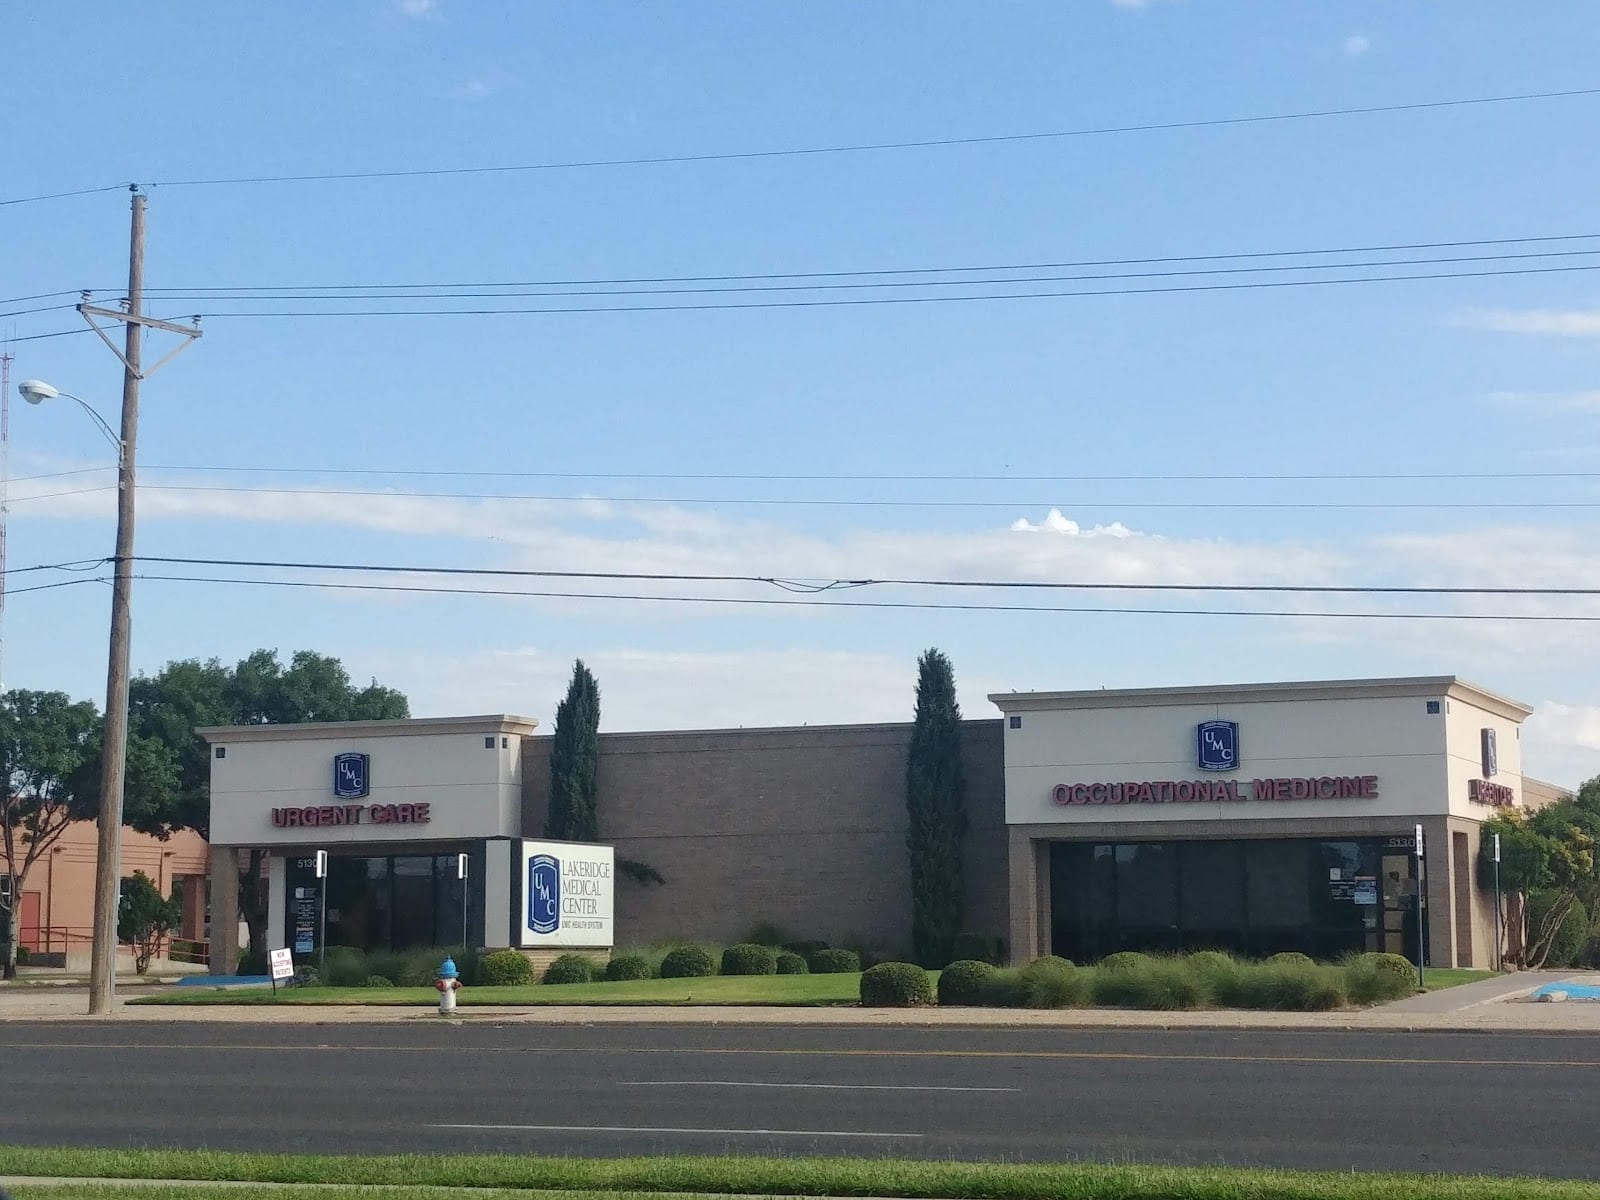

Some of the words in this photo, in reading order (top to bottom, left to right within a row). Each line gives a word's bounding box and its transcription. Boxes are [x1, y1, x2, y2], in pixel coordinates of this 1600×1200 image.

[1205, 731, 1231, 760] UMC
[340, 762, 361, 788] UMC
[1052, 780, 1247, 806] OCCUPATIONAL
[1253, 775, 1378, 801] MEDICINE
[271, 805, 363, 828] URGENT
[368, 803, 430, 824] CARE
[562, 859, 610, 879] LAKERIDGE
[535, 872, 555, 916] UMC
[562, 879, 601, 896] MEDICAL
[562, 897, 598, 914] CENTER
